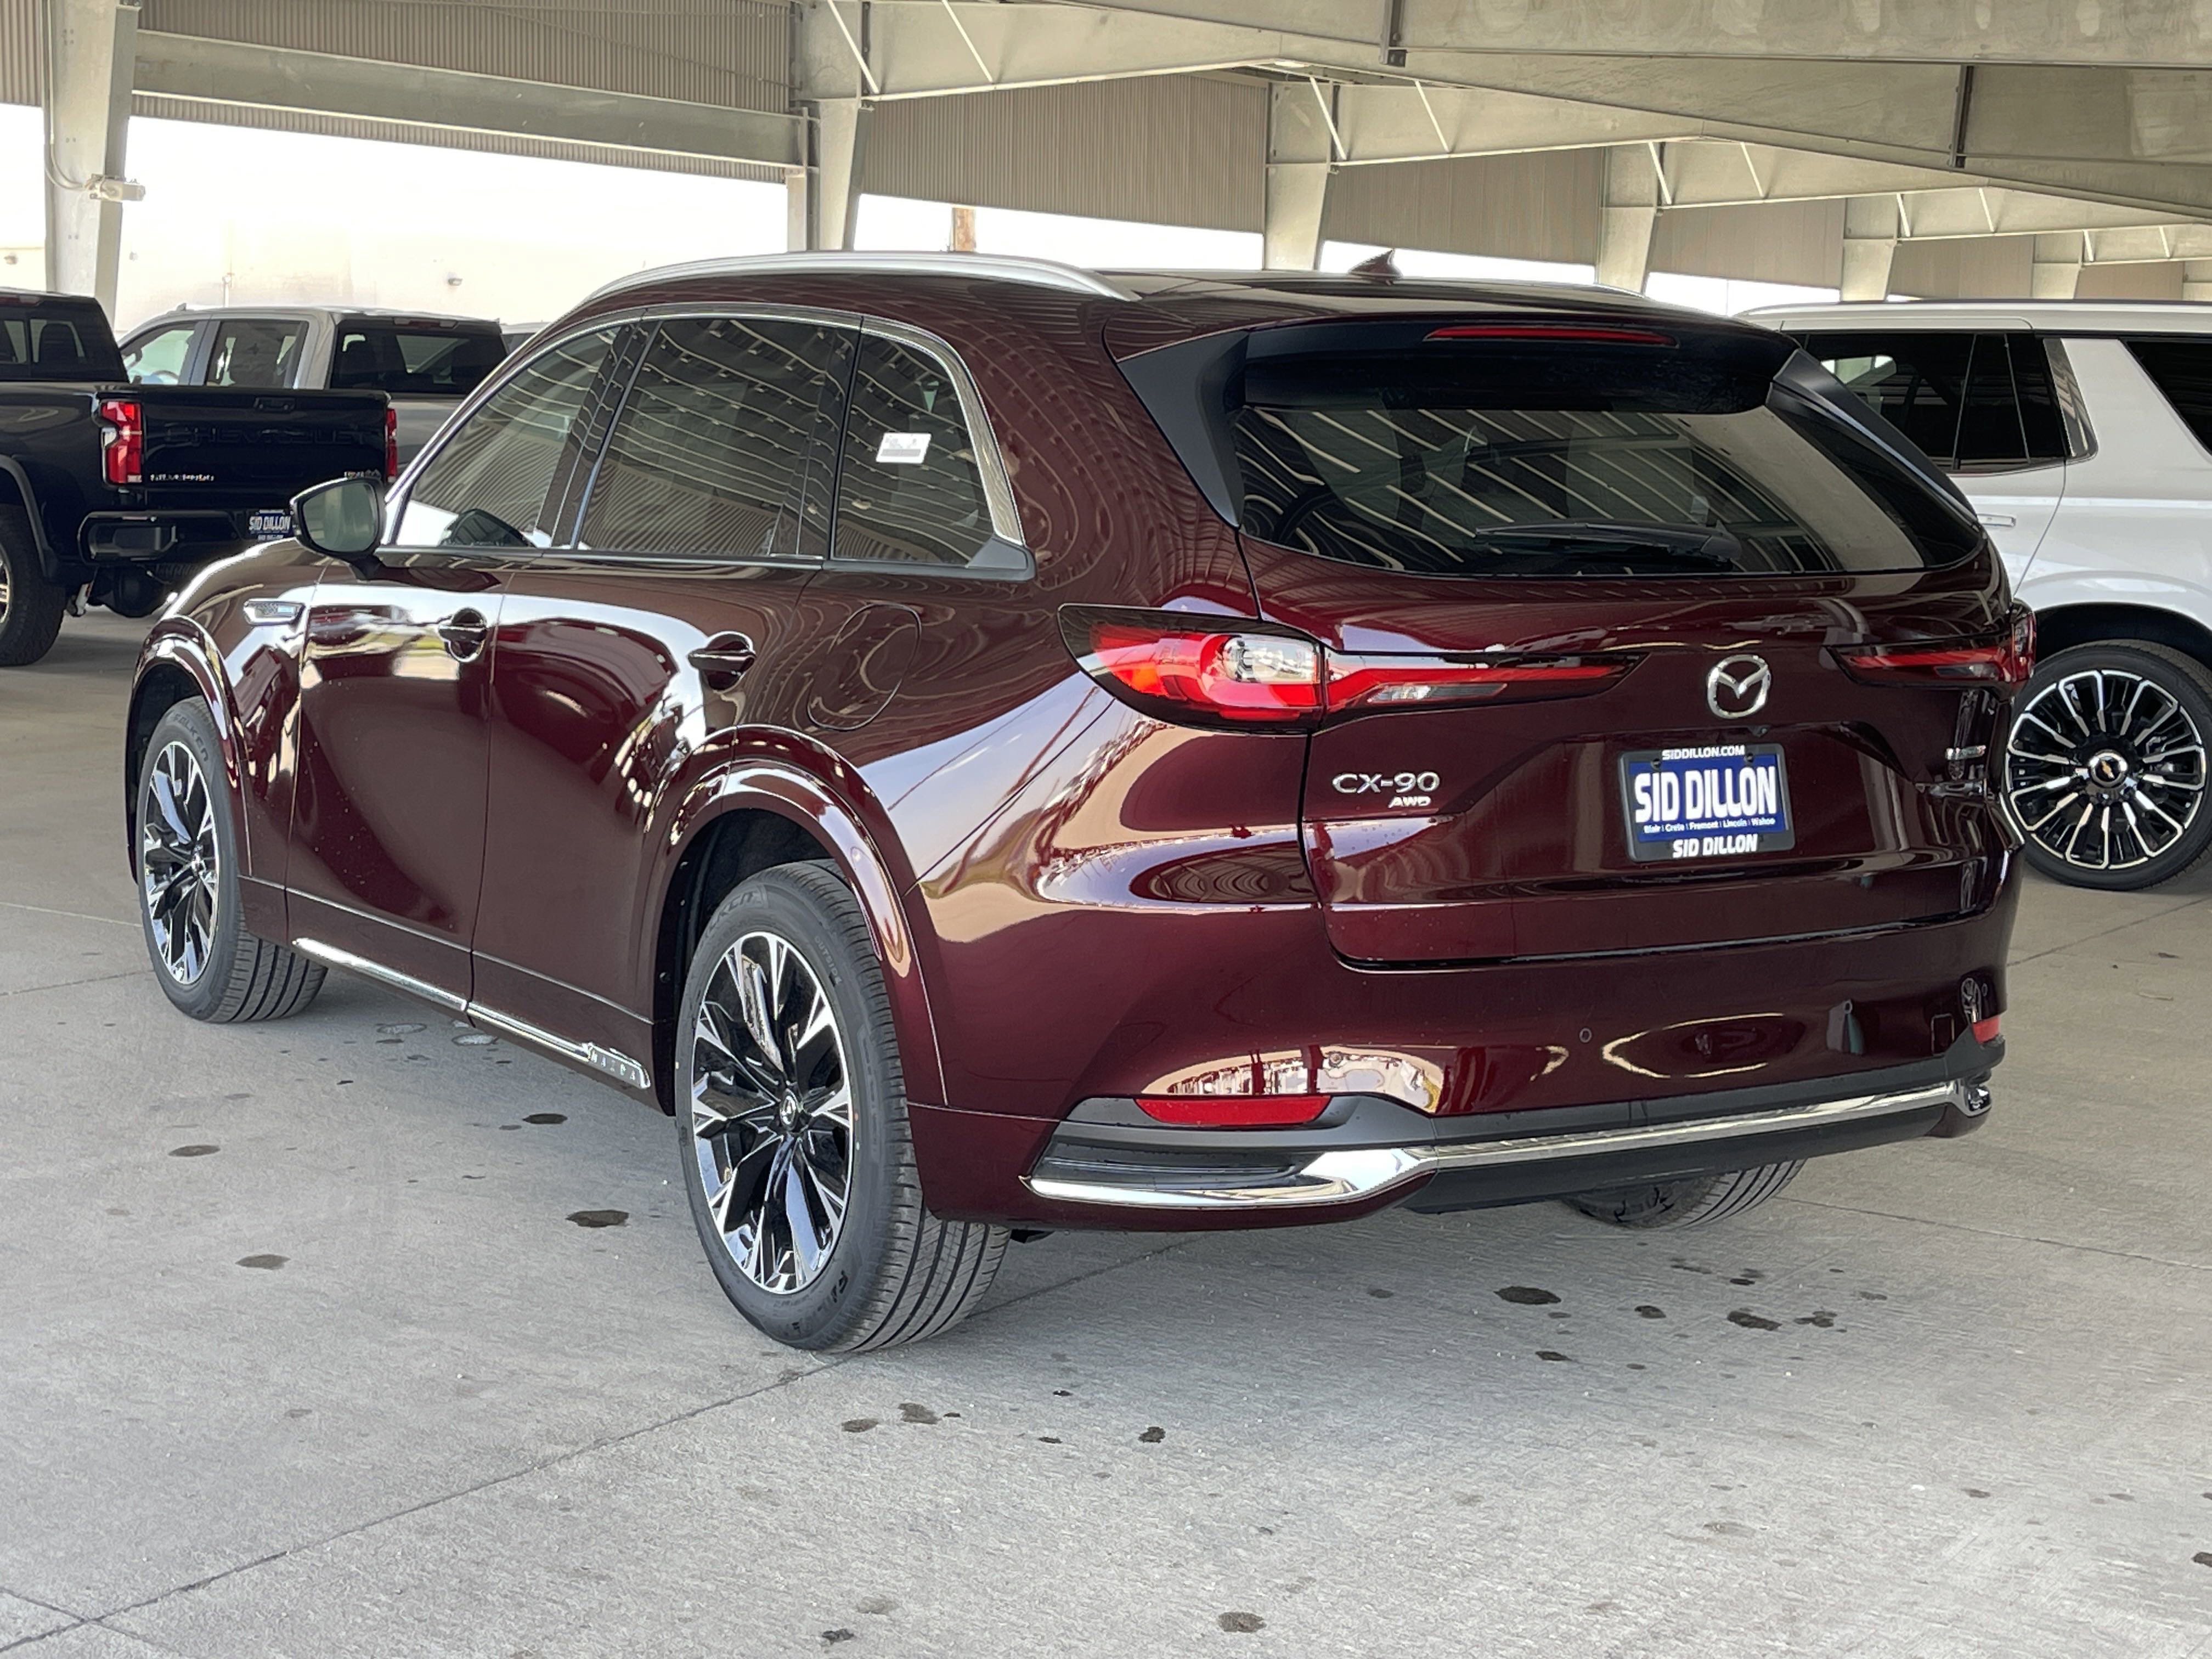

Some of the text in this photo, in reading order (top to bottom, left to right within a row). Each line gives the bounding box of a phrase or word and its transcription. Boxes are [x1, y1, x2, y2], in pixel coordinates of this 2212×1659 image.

[249, 516, 291, 530] SID DILLON
[1662, 745, 1745, 760] SIDDILLON.COM
[1332, 771, 1440, 793] CX-90
[1387, 795, 1431, 808] AWD
[1635, 766, 1776, 823] SID DILLON
[1673, 833, 1758, 859] SID DILLON
